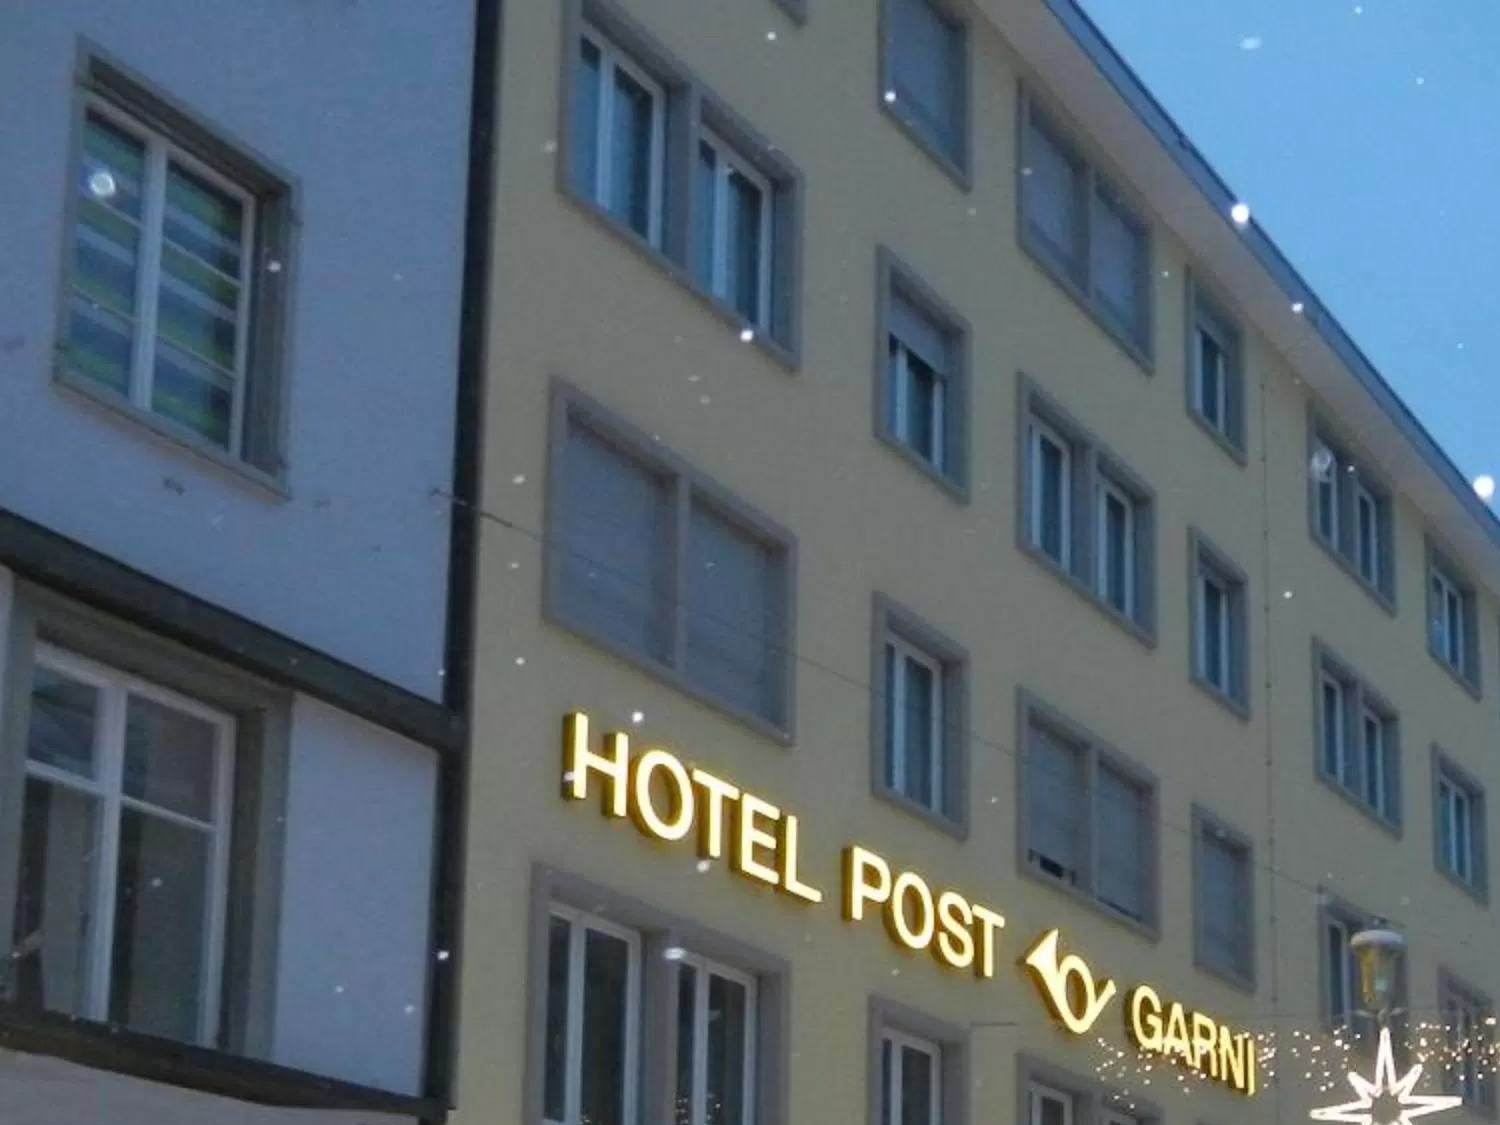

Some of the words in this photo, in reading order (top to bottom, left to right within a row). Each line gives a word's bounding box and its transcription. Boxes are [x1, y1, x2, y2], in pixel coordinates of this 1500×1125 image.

[563, 711, 823, 903] HOTEL
[843, 845, 1006, 979] POST
[1127, 984, 1256, 1096] GARNI
